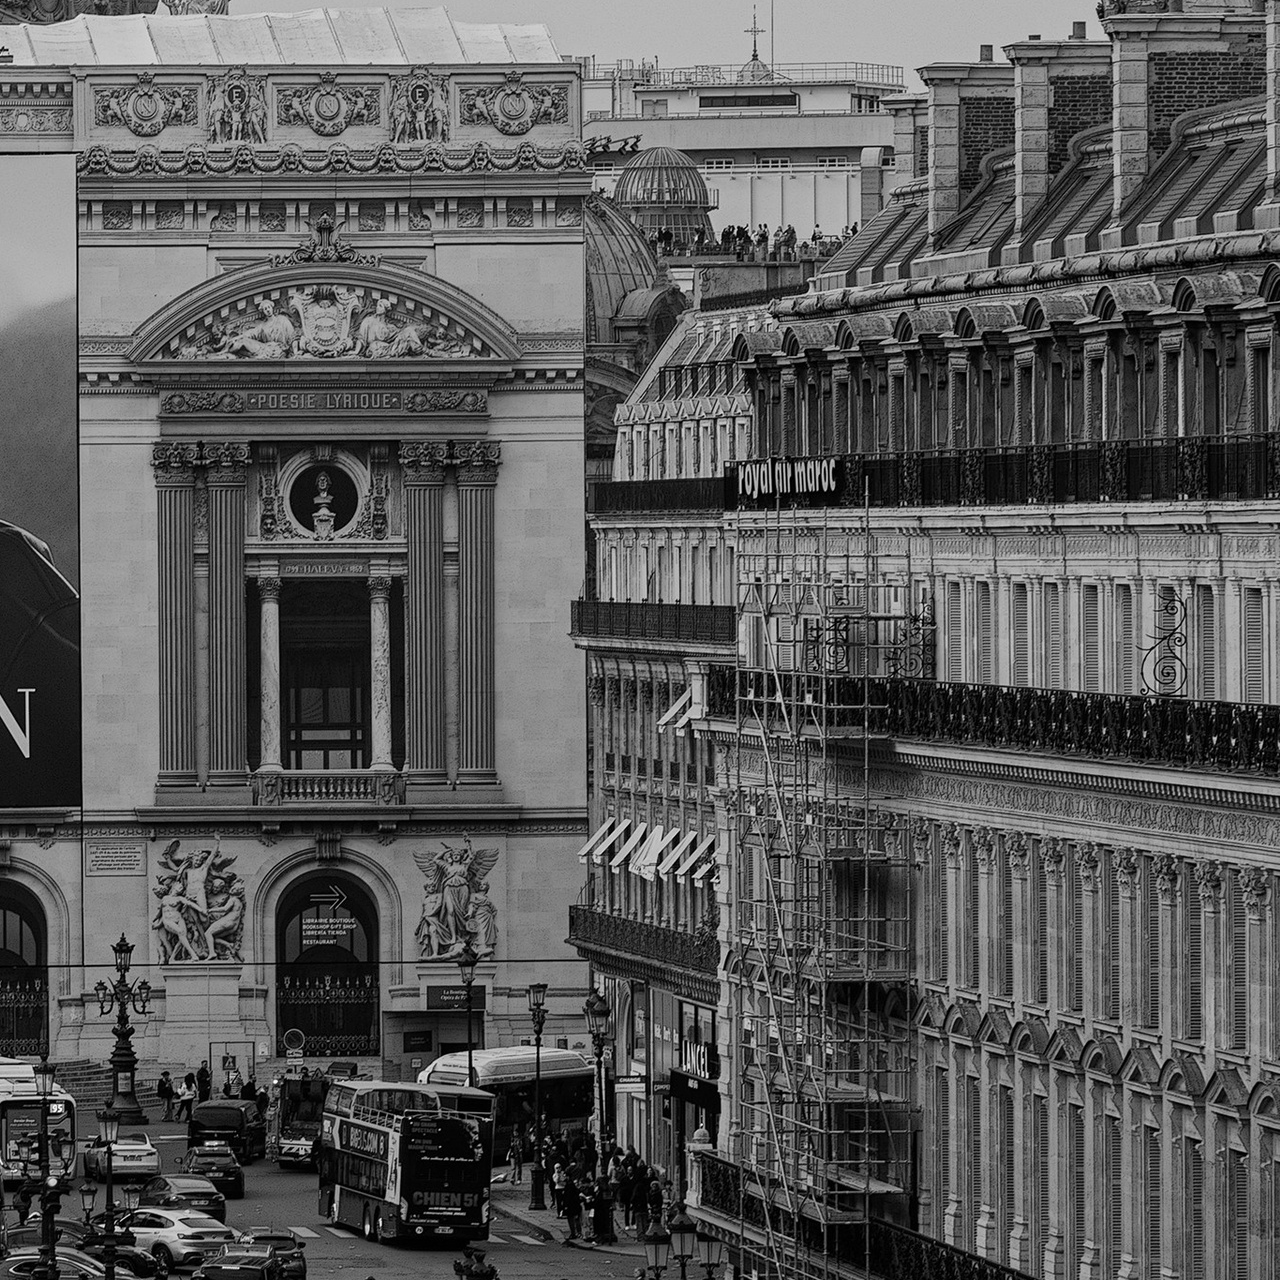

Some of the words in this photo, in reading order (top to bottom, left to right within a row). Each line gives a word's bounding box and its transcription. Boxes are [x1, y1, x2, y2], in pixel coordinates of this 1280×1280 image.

[258, 394, 316, 409] POESIE
[326, 393, 391, 409] LYRIQUE
[738, 457, 773, 499] royal
[775, 457, 792, 493] air
[794, 458, 836, 493] maroc
[682, 1039, 710, 1079] LANCEL
[52, 1103, 64, 1113] 95
[413, 1191, 461, 1207] CHIEN
[463, 1193, 478, 1207] 51
